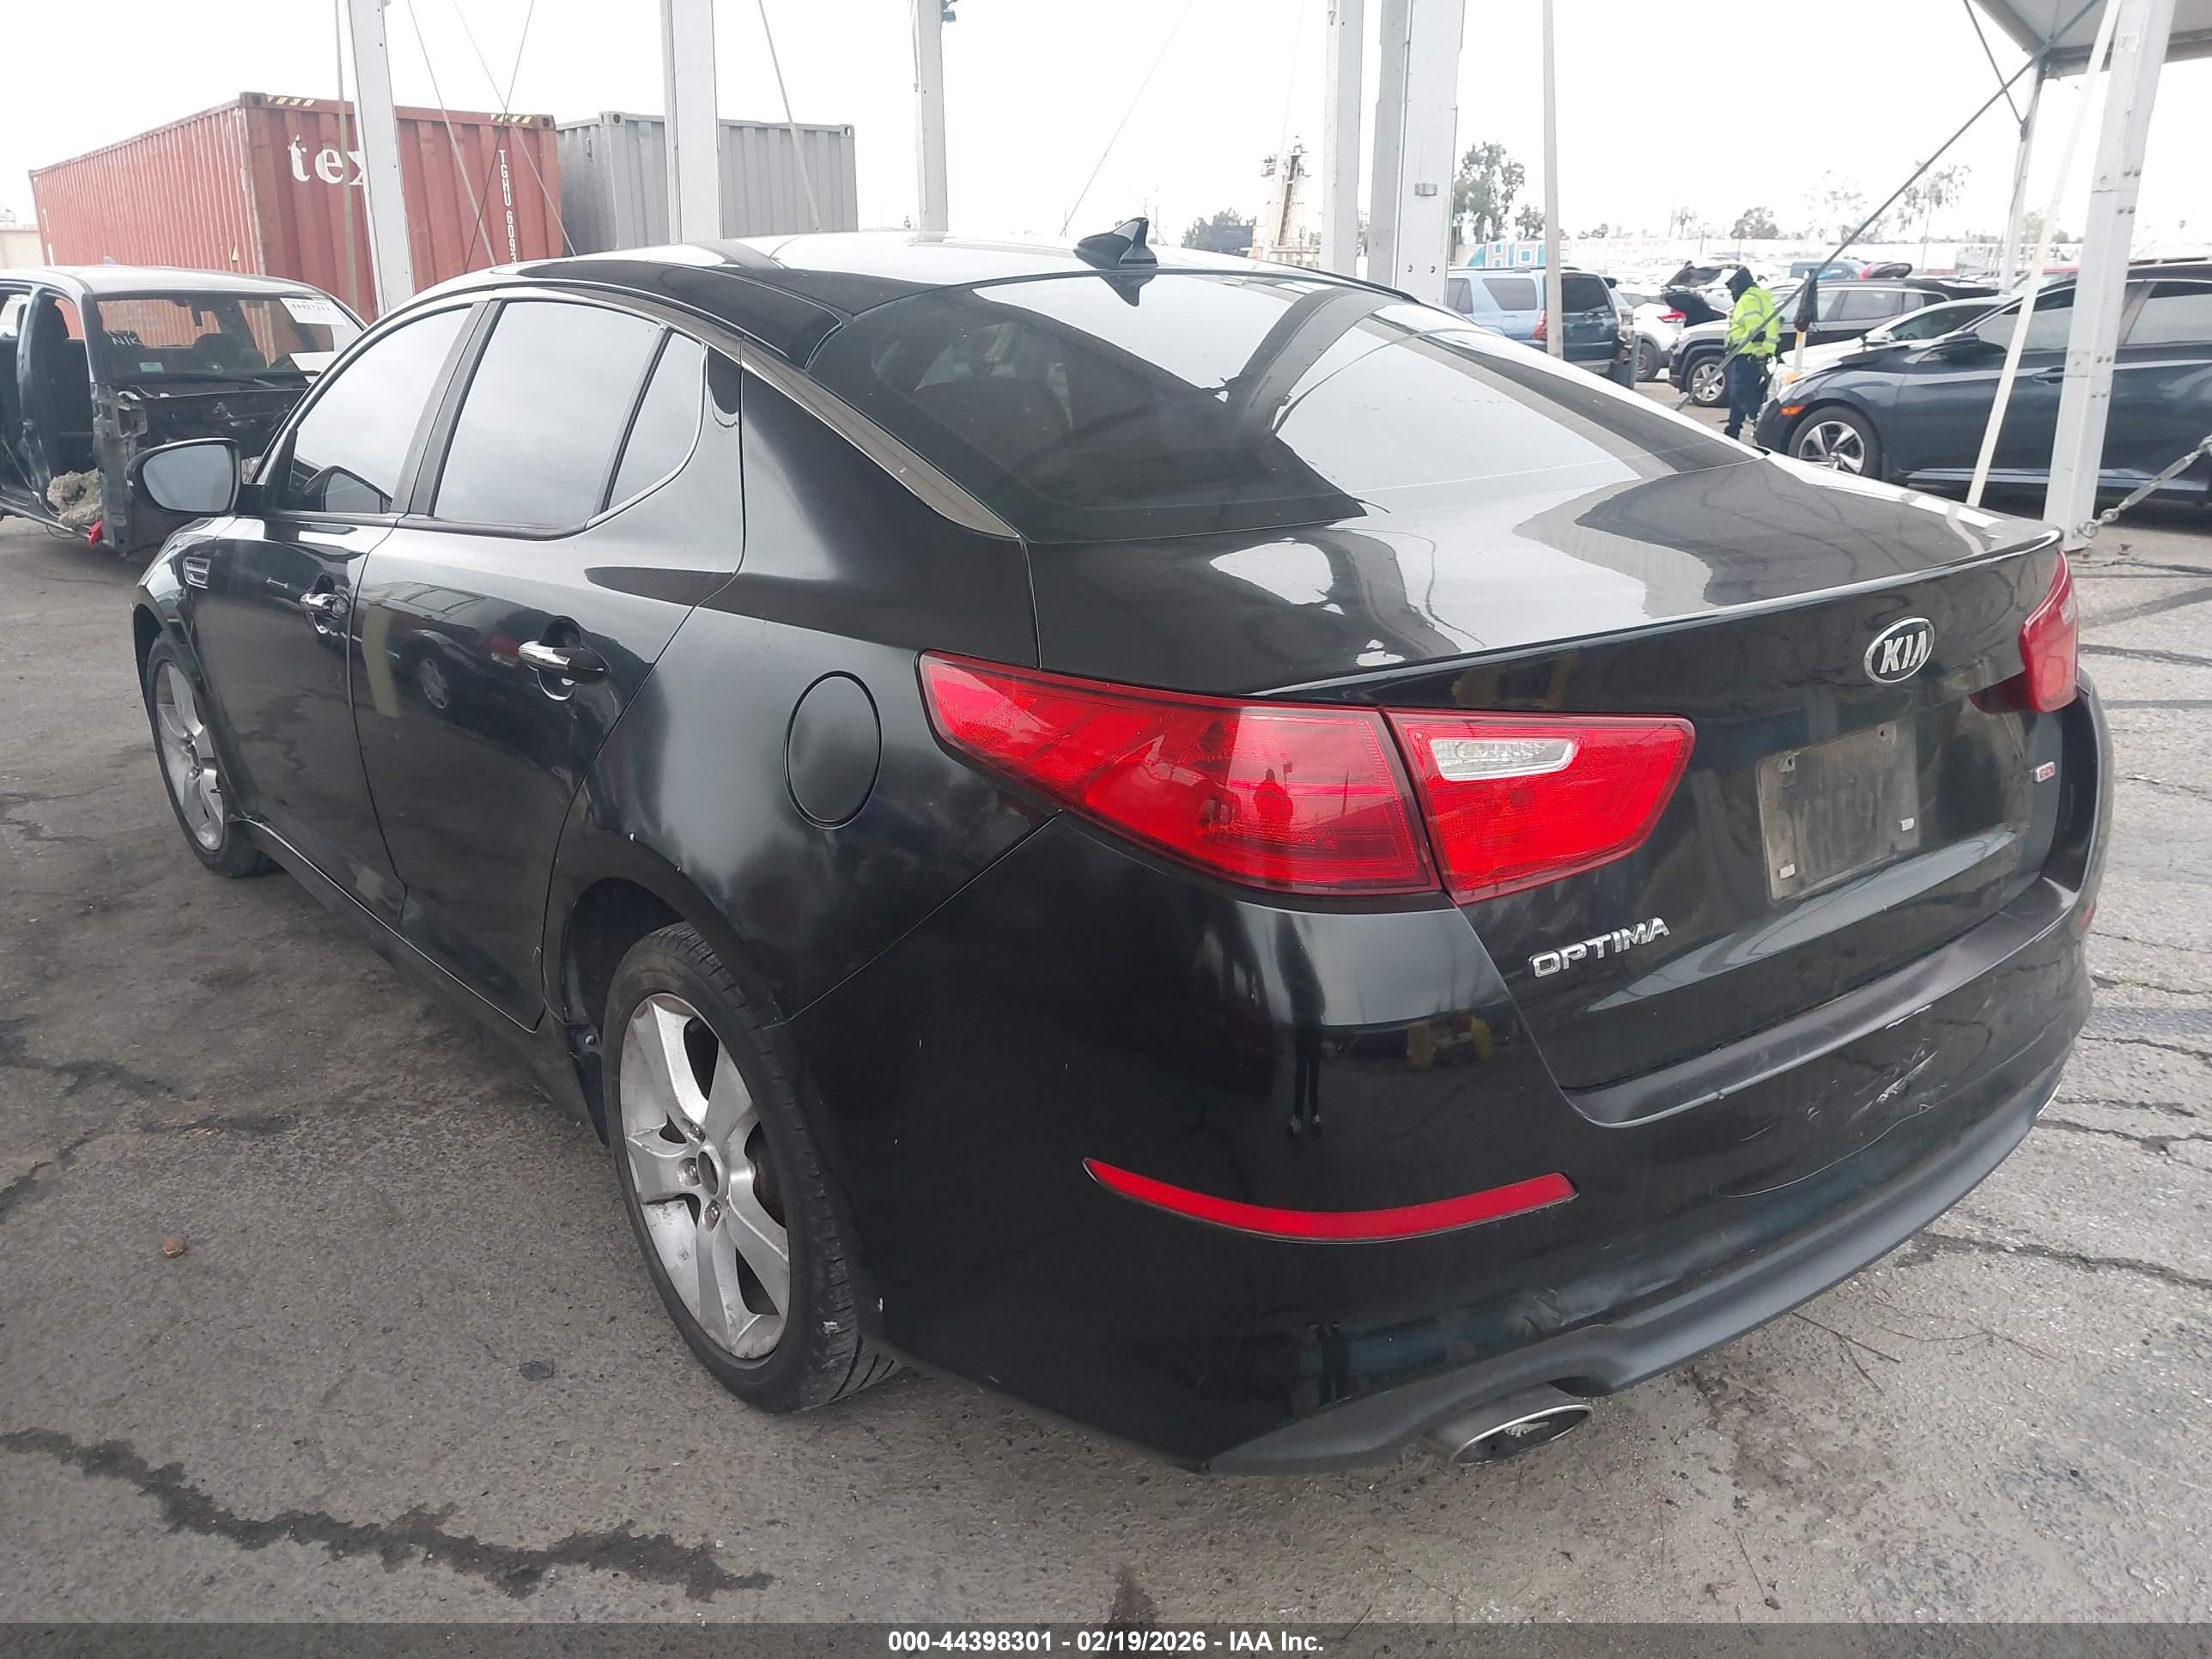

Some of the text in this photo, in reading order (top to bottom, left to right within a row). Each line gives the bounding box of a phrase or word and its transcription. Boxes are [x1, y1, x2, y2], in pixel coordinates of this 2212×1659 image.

[498, 149, 511, 206] TGHU
[1879, 630, 1927, 674] KIA
[1529, 917, 1671, 978] OPTIMA
